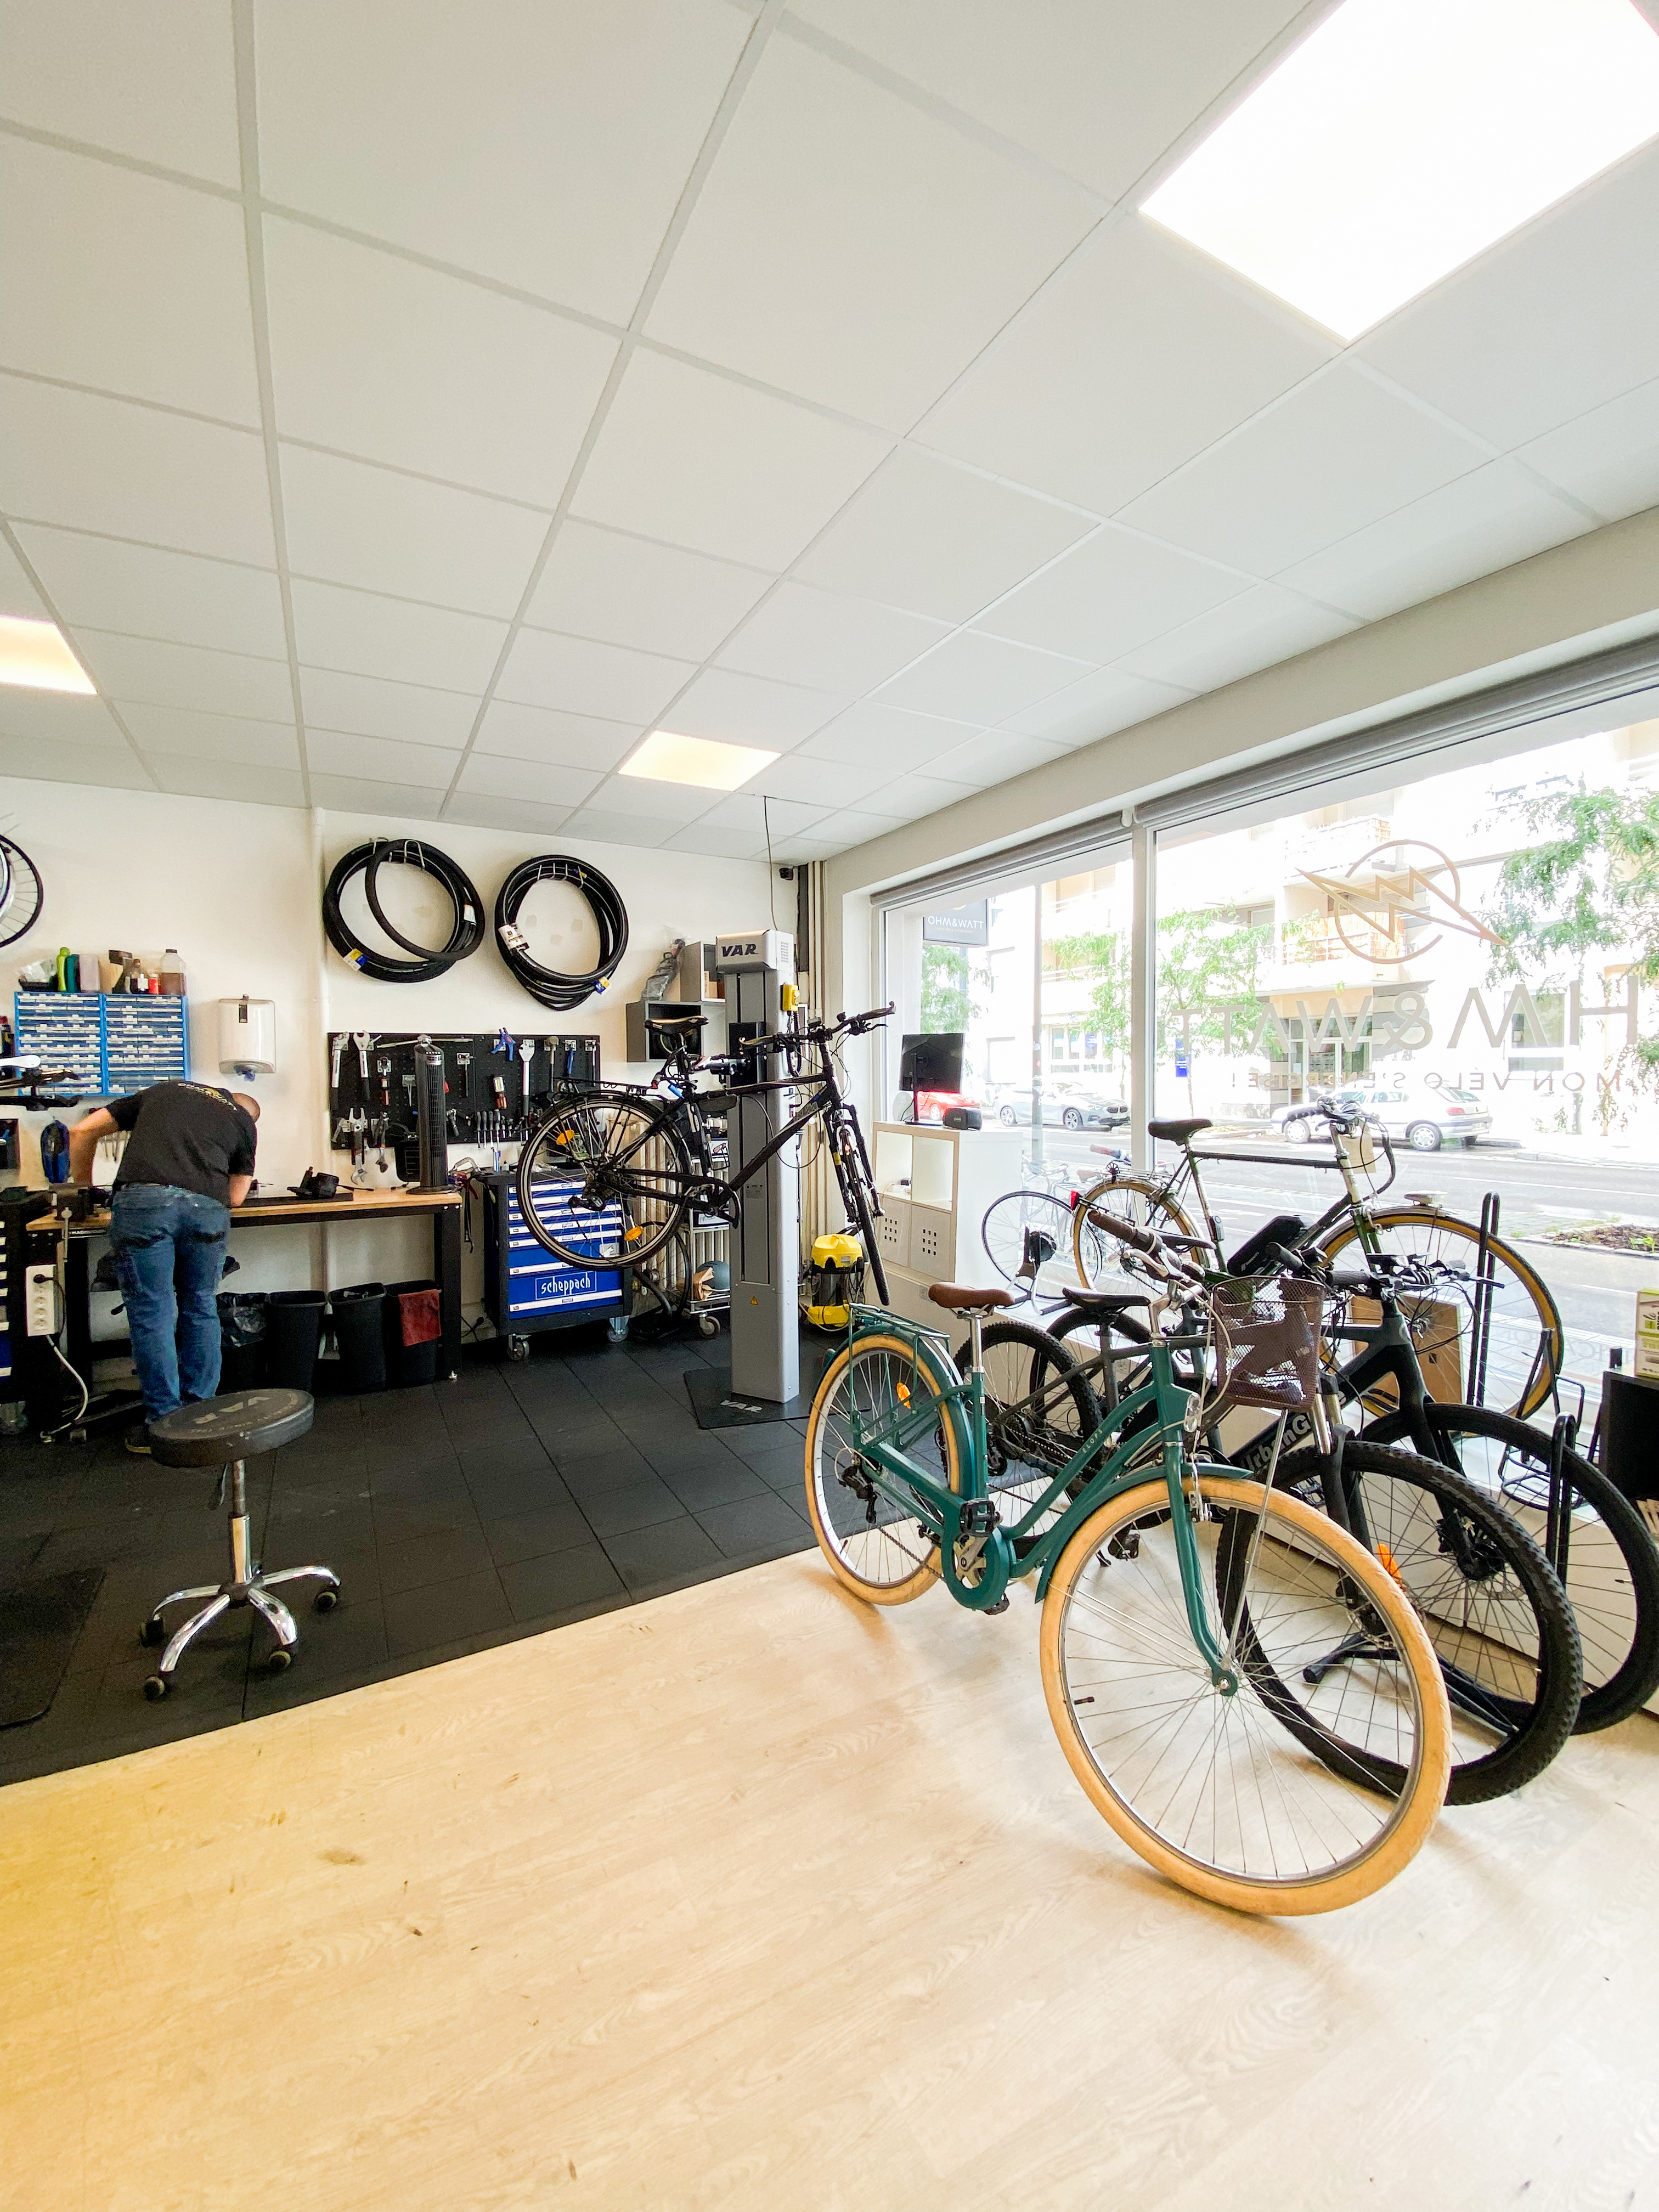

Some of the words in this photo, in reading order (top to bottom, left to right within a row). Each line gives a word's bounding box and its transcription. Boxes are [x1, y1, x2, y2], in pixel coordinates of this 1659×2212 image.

[928, 915, 984, 929] OHM&WATT
[721, 944, 759, 957] VAR
[541, 1272, 590, 1296] scheppach
[1082, 1428, 1103, 1453] ELOPS
